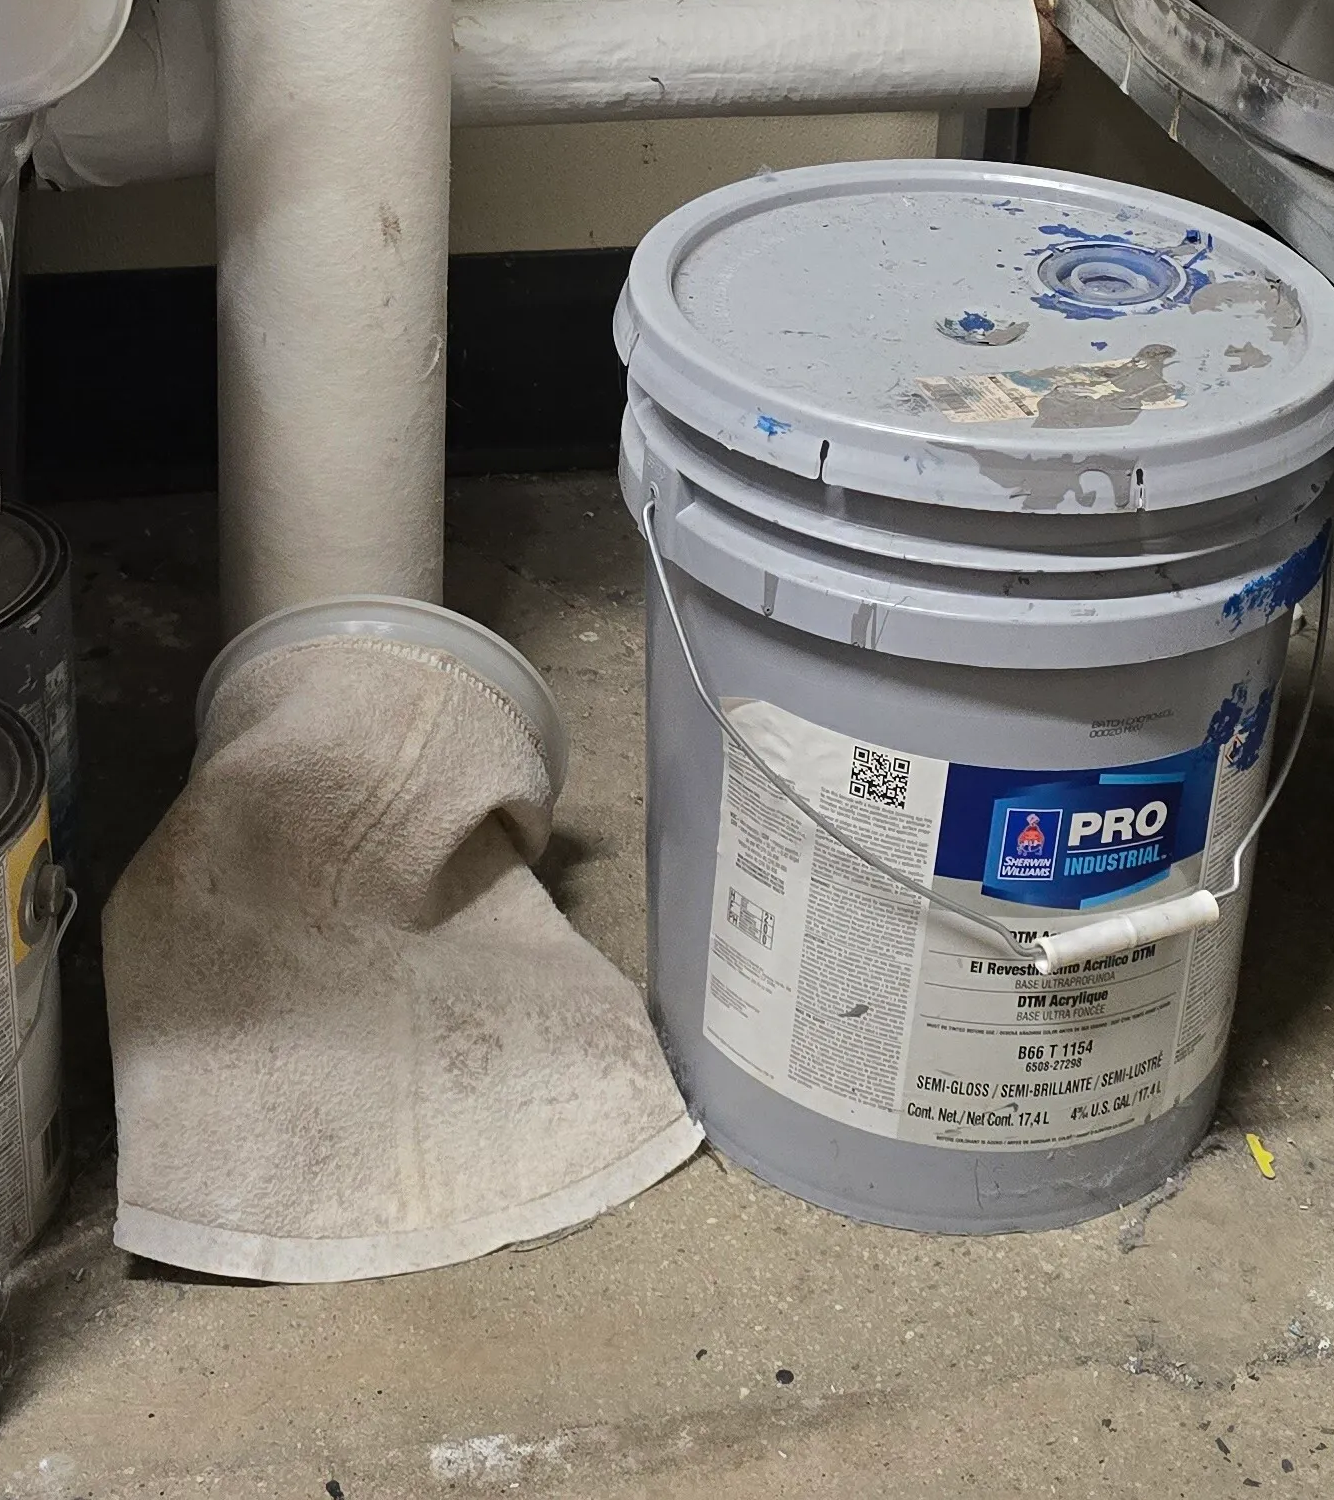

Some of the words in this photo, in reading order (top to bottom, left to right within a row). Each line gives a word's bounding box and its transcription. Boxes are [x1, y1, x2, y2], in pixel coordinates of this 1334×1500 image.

[1068, 800, 1167, 846] PRO
[1004, 856, 1051, 866] SHERWIN
[1064, 844, 1160, 876] INDUSTRIAL
[1002, 866, 1050, 876] WILLIAMS
[970, 961, 982, 973] El
[1132, 944, 1155, 962] DTM
[1015, 980, 1038, 990] BASE
[1042, 971, 1116, 988] ULTRAPROFUNDA
[1018, 996, 1046, 1008] DTM
[1049, 990, 1108, 1007] Acrylique
[1017, 1011, 1039, 1021] BASE
[1043, 1008, 1070, 1021] ULTRA
[1074, 1004, 1105, 1018] FONCÉE
[1018, 1046, 1043, 1060] B66
[1049, 1045, 1058, 1058] T
[1063, 1040, 1093, 1057] 1154
[917, 1076, 989, 1098] SEMI-GLOSS
[1001, 1076, 1092, 1098] SEMI-BRILLANTE
[1101, 1050, 1163, 1088] SEMI-LUSTRÉ
[1025, 1058, 1082, 1073] 6508-27298
[908, 1103, 934, 1121] Cont.
[987, 1112, 1014, 1126] Cont.
[1018, 1112, 1041, 1128] 17,4
[1042, 1111, 1049, 1125] L
[1091, 1101, 1110, 1117] U.S.
[1113, 1094, 1130, 1111] GAL
[1139, 1083, 1155, 1102] 17.4
[1157, 1081, 1161, 1094] L
